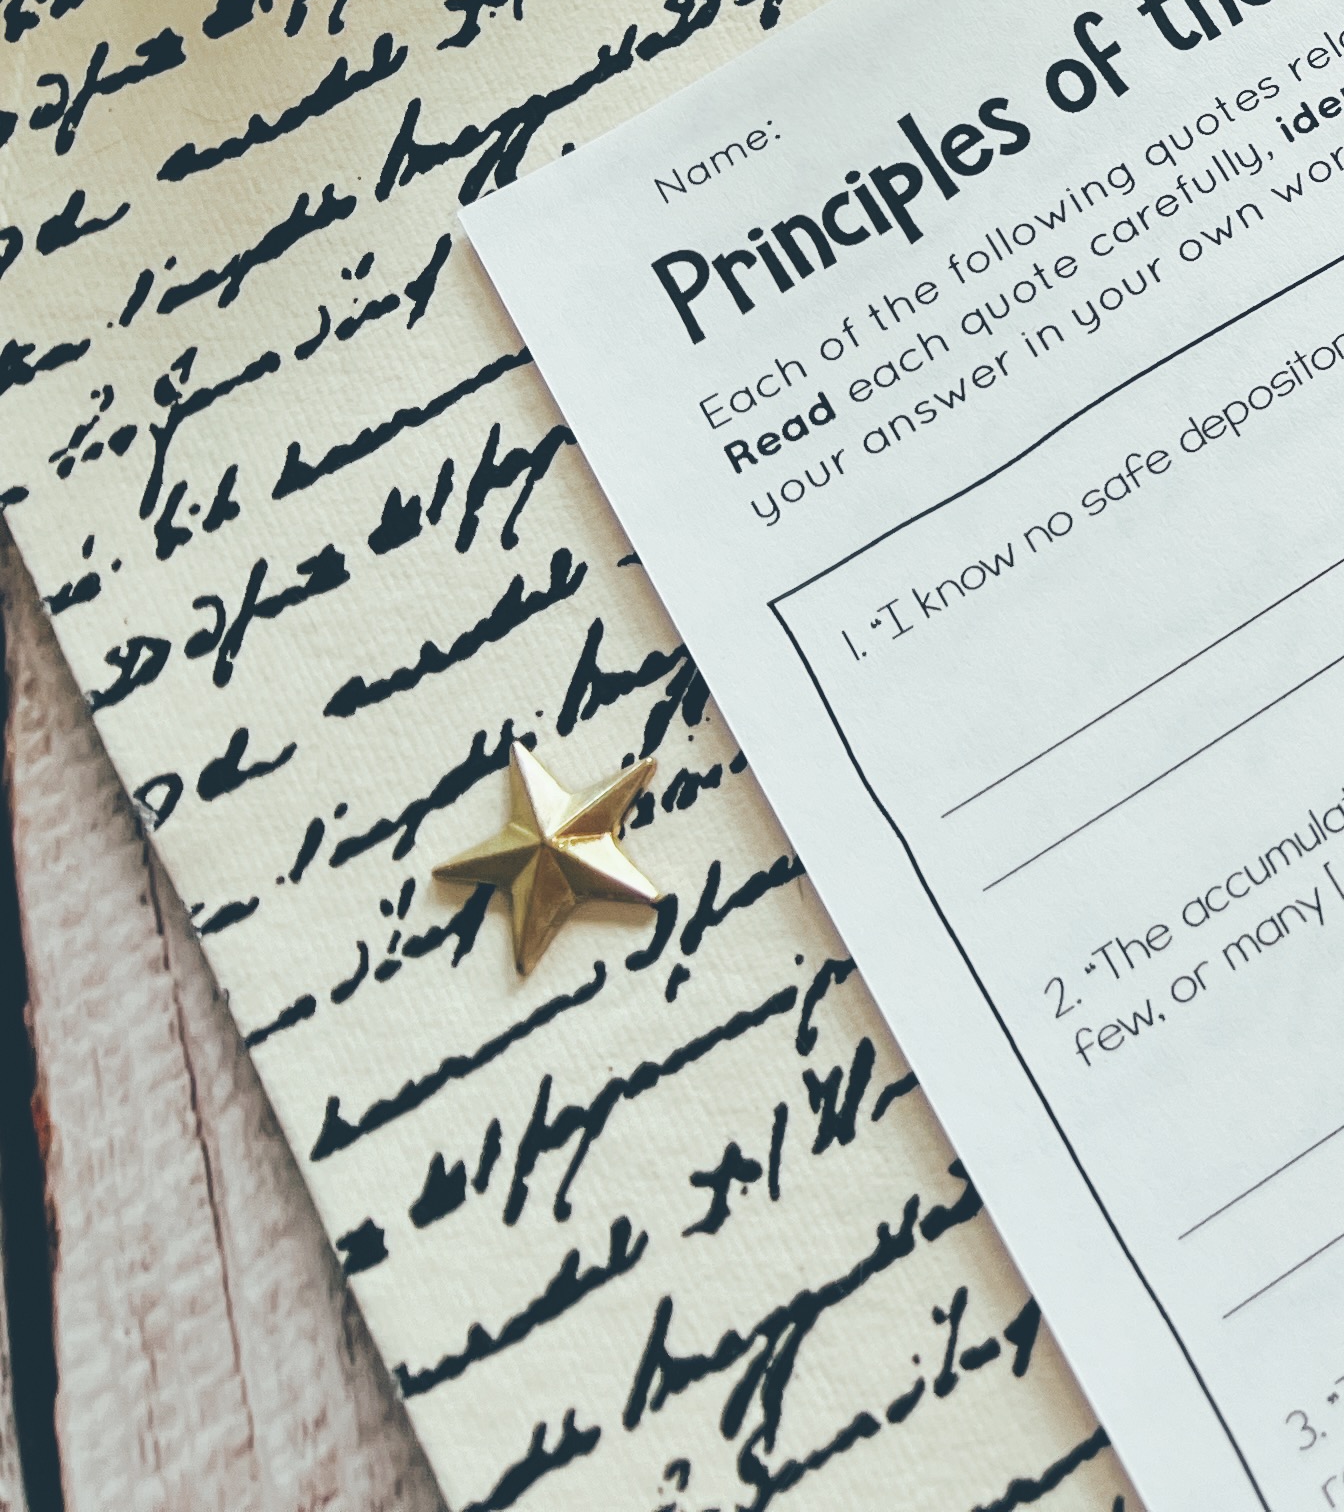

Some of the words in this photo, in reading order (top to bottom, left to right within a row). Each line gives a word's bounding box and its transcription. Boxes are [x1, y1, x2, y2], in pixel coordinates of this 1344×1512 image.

[649, 96, 1032, 347] Principles
[1044, 10, 1131, 115] of
[653, 119, 782, 205] Name:
[698, 357, 809, 431] Each
[819, 315, 861, 362] of
[867, 280, 940, 332] the
[947, 162, 1137, 285] following
[1144, 75, 1281, 167] quotes
[722, 390, 838, 476] Read
[848, 332, 951, 404] each
[960, 254, 1079, 337] quote
[1089, 142, 1275, 258] carefully,
[749, 447, 846, 528] your
[862, 349, 1009, 455] answer
[1020, 324, 1066, 359] in
[1070, 256, 1162, 336] your
[1178, 202, 1265, 263] own
[910, 541, 1016, 620] know
[1022, 510, 1074, 554] no
[1080, 448, 1173, 518] safe
[1043, 975, 1083, 1020] 2.
[1074, 997, 1167, 1068] few,
[1169, 959, 1209, 1005] or
[1221, 885, 1325, 972] many
[1284, 1409, 1328, 1452] 3.
